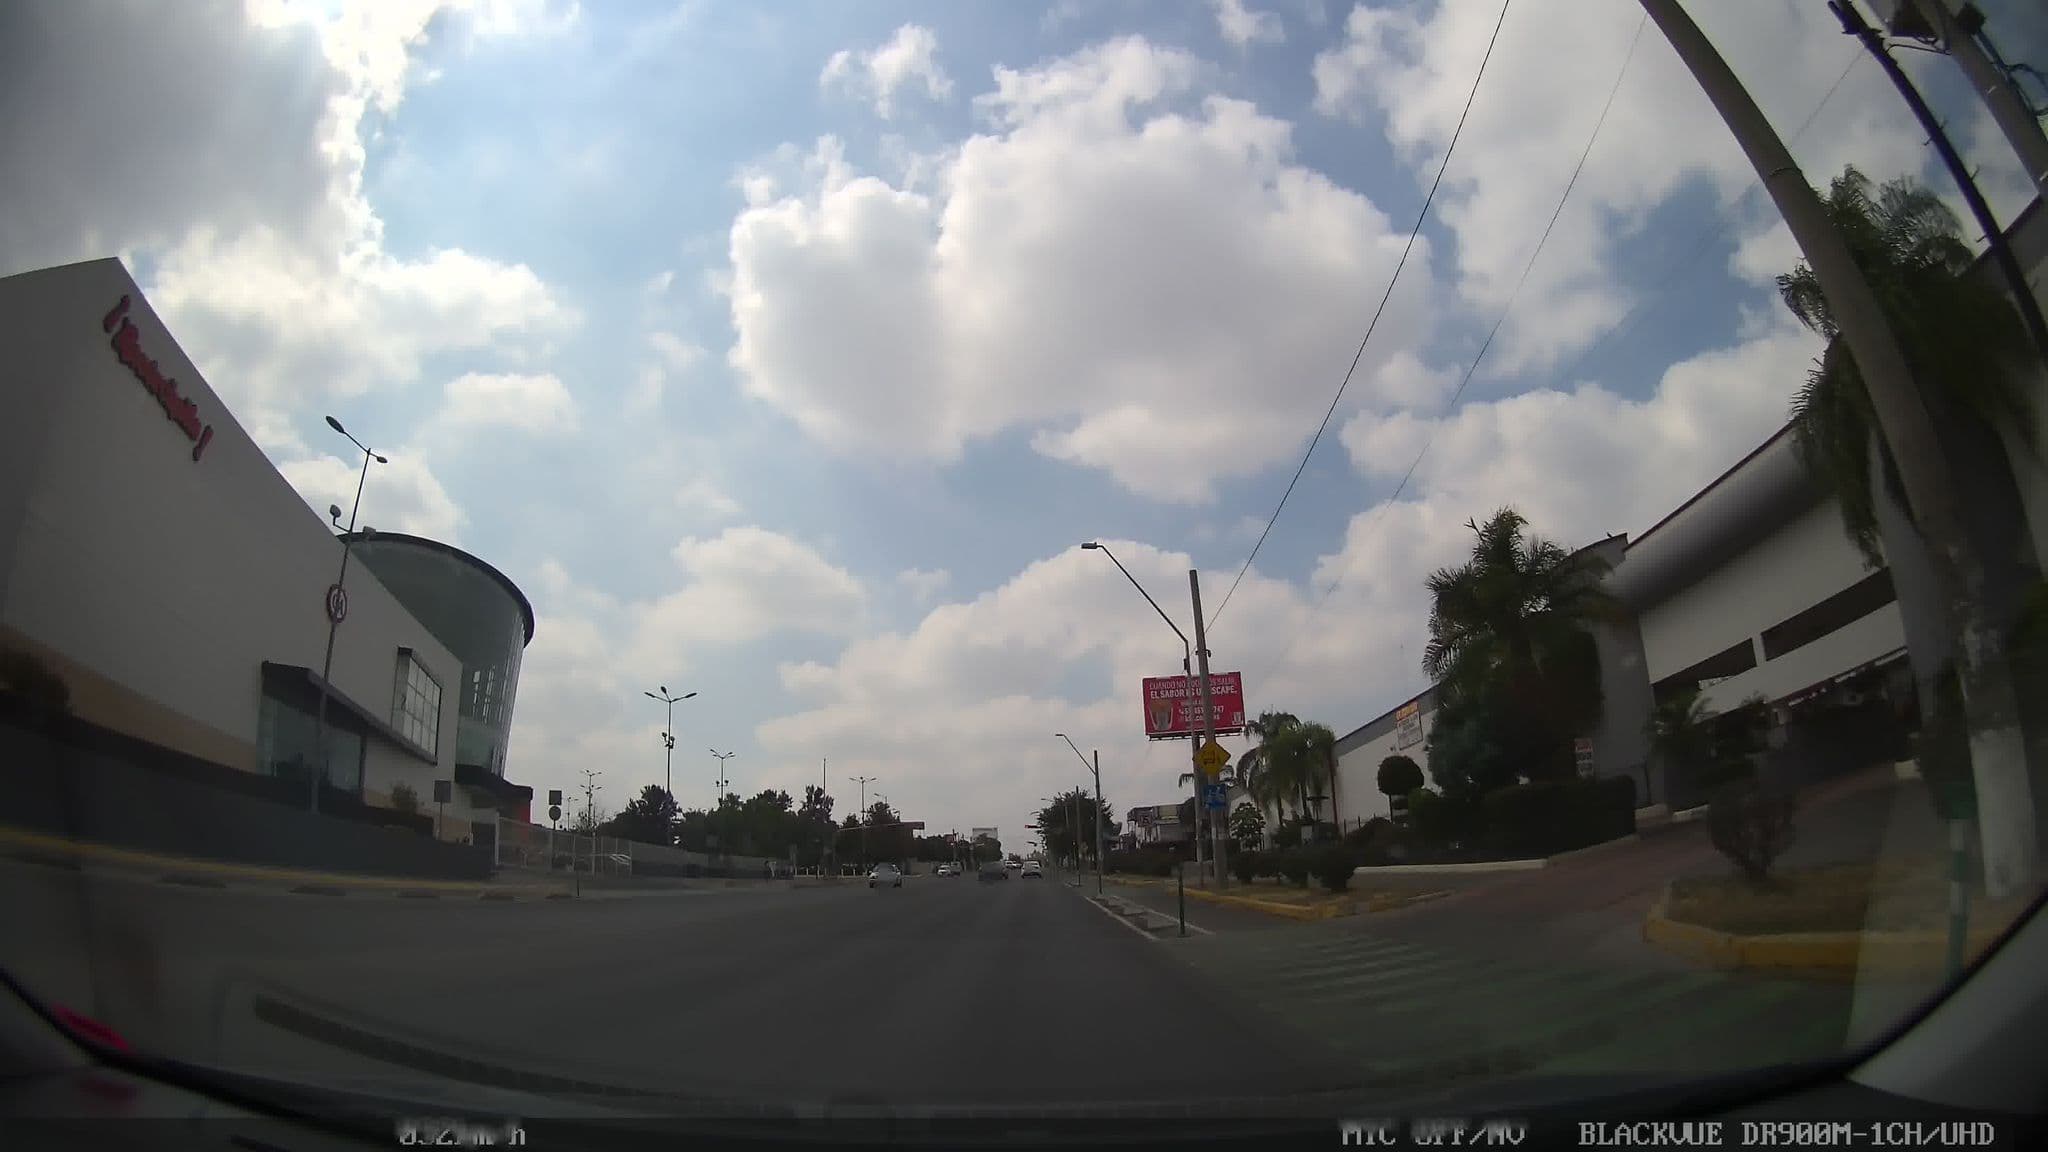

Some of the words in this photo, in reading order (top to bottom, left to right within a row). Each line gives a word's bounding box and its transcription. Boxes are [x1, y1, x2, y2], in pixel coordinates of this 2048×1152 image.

[1150, 689, 1160, 699] EL
[1160, 688, 1185, 698] SABOR
[1211, 685, 1238, 695] SCAPE.
